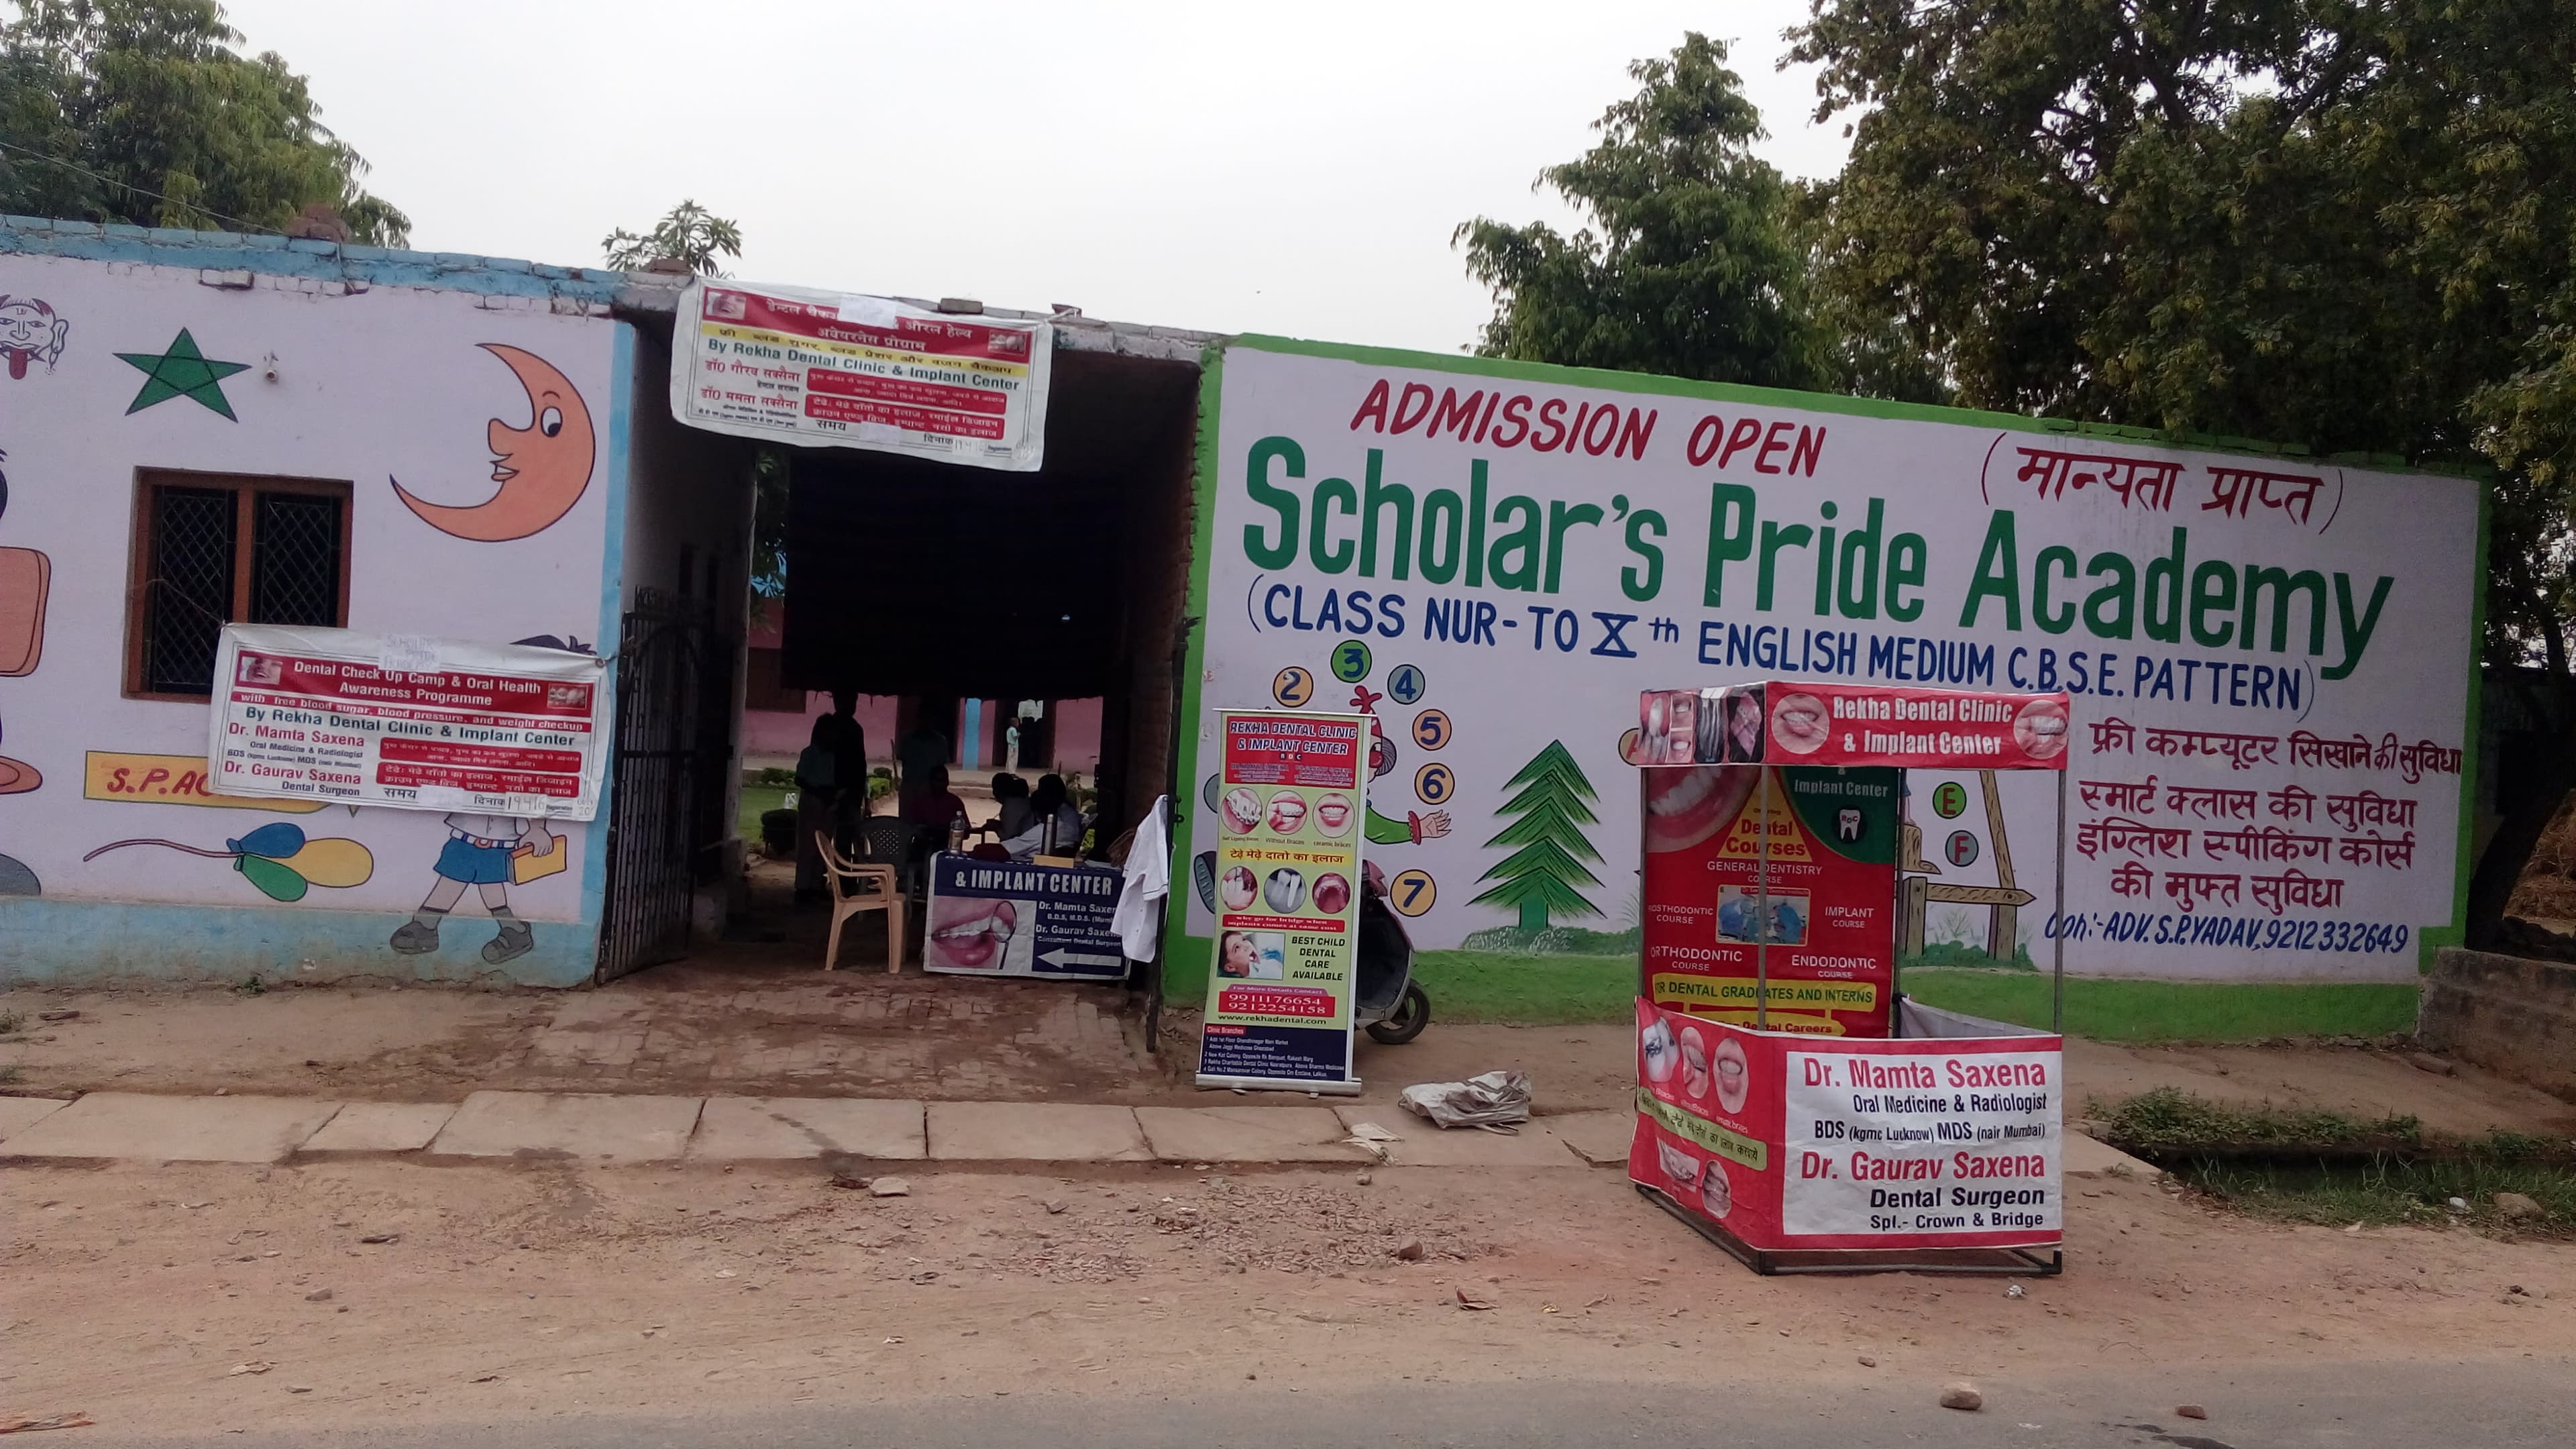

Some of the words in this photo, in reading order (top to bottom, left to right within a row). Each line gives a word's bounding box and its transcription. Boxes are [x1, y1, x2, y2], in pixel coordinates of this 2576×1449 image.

[708, 338, 727, 354] By
[733, 343, 780, 360] Rekha
[788, 350, 837, 367] Dental
[843, 358, 885, 374] Clinic
[892, 366, 903, 376] &
[910, 367, 967, 385] Implant
[972, 374, 1019, 391] Center
[731, 359, 759, 376] गौरव
[724, 390, 755, 405] ममता
[816, 419, 847, 431] समय
[1350, 378, 1658, 461] ADMISSION
[1686, 414, 1827, 478] OPEN
[1242, 435, 1668, 602] Scholar's
[1703, 482, 1927, 623] Pride
[1957, 508, 2395, 680] Academy
[1342, 648, 1364, 678] 3
[1698, 620, 1857, 676] ENGLISH
[1868, 635, 1994, 687] MEDIUM
[293, 661, 337, 676] Dental
[341, 665, 380, 681] Check
[385, 669, 403, 684] Up
[408, 672, 445, 688] Camp
[451, 676, 462, 688] &
[466, 677, 494, 691] Oral
[498, 679, 541, 695] Health
[1280, 671, 1301, 700] 2
[1395, 669, 1417, 700] 4
[339, 682, 411, 699] Awareness
[416, 689, 492, 706] Programme
[240, 693, 266, 703] with
[274, 696, 296, 706] free
[300, 698, 333, 710] blood
[377, 707, 410, 718] blood
[472, 714, 494, 726] and
[498, 717, 535, 730] weight
[538, 720, 583, 733] checkup
[1833, 696, 1890, 720] Rekha
[1895, 698, 1955, 722] Dental
[1958, 699, 2013, 724] Clinic
[229, 722, 249, 736] Dr.
[255, 724, 306, 741] Mamta
[311, 730, 365, 747] Saxena
[246, 706, 266, 721] By
[272, 709, 323, 726] Rekha
[329, 715, 380, 732] Dental
[388, 720, 433, 736] Clinic
[440, 725, 452, 737] &
[459, 727, 519, 744] Implant
[524, 731, 576, 747] Center
[1230, 721, 1268, 735] REKHA
[1271, 723, 1316, 737] DENTAL
[1319, 726, 1358, 739] CLINIC
[1420, 716, 1442, 745] 5
[250, 741, 267, 750] Oral
[269, 742, 305, 753] Medicine
[317, 747, 364, 759] Radiologist
[1238, 739, 1246, 750] &
[1248, 739, 1300, 753] IMPLANT
[1303, 741, 1348, 755] CENTER
[1843, 733, 1856, 752] &
[1864, 729, 1937, 757] Implant
[1939, 731, 2002, 756] Center
[227, 749, 246, 757] BDS
[297, 756, 317, 765] MDS
[2288, 730, 2371, 770] सिखाने
[2373, 731, 2400, 771] की
[2399, 739, 2464, 785] सुविधा
[224, 760, 246, 774] Dr.
[251, 763, 303, 780] Gaurav
[309, 768, 362, 785] Saxena
[1422, 768, 1446, 800] 6
[282, 781, 315, 793] Dental
[318, 784, 361, 797] Surgeon
[382, 787, 418, 800] समय
[1794, 779, 1843, 796] Implant
[1845, 782, 1889, 798] Center
[1941, 788, 1957, 815] E
[2078, 775, 2159, 816] स्मार्ट
[2166, 785, 2258, 821] क्लास
[2267, 784, 2318, 823] की
[2325, 790, 2418, 833] सुविधा
[1953, 836, 1970, 863] F
[2076, 816, 2192, 863] इंग्लिश
[2339, 828, 2417, 871] कोर्स
[1294, 853, 1309, 861] का
[1311, 853, 1345, 864] इलाज
[1707, 861, 1760, 872] GENERAL
[955, 871, 967, 888] &
[971, 869, 1046, 892] IMPLANT
[1049, 873, 1113, 896] CENTER
[1402, 879, 1426, 908] 7
[2110, 860, 2154, 903] की
[2249, 867, 2345, 917] सुविधा
[1038, 901, 1051, 910] Dr.
[1054, 902, 1087, 912] Mamta
[1825, 906, 1874, 918] IMPLANT
[1035, 924, 1049, 933] Dr.
[1051, 925, 1085, 935] Gaurav
[1656, 914, 1694, 924] COURSE
[1832, 919, 1866, 929] COURSE
[1291, 936, 1315, 945] BEST
[1318, 937, 1346, 947] CHILD
[1299, 947, 1336, 958] DENTAL
[1304, 959, 1330, 969] CARE
[1650, 945, 1743, 963] ORTHODONTIC
[1791, 954, 1877, 970] ENDODONTIC
[1292, 971, 1344, 981] AVAILABLE
[1671, 961, 1710, 971] COURSE
[1817, 970, 1854, 979] COURSE
[1668, 981, 1719, 998] DENTAL
[1796, 988, 1822, 1001] AND
[1825, 988, 1873, 1004] INTERNS
[1218, 1014, 1327, 1025] www.rekhadental.com
[1228, 1002, 1326, 1015] 9212254158
[1785, 1022, 1833, 1033] Careers
[1803, 1057, 1841, 1087] Dr.
[1847, 1058, 1937, 1089] Mamta
[1945, 1058, 2047, 1088] Saxena
[1853, 1094, 1880, 1114] Oral
[1884, 1095, 1947, 1114] Medicine
[1953, 1093, 1966, 1112] &
[1970, 1091, 2048, 1116] Radiologist
[1814, 1120, 1845, 1139] BDS
[1849, 1126, 1883, 1143] (kgmc
[1886, 1126, 1935, 1144] Lucknow)
[1936, 1121, 1973, 1140] MDS
[2003, 1122, 2046, 1140] Mumbai)
[1801, 1150, 1839, 1180] Dr.
[1850, 1150, 1944, 1181] Gaurav
[1951, 1150, 2046, 1179] Saxena
[1869, 1187, 1942, 1209] Dental
[1950, 1185, 2046, 1209] Surgeon
[1915, 1214, 1966, 1229] Crown
[1972, 1212, 1985, 1228] &
[1990, 1212, 2045, 1229] Bridge
